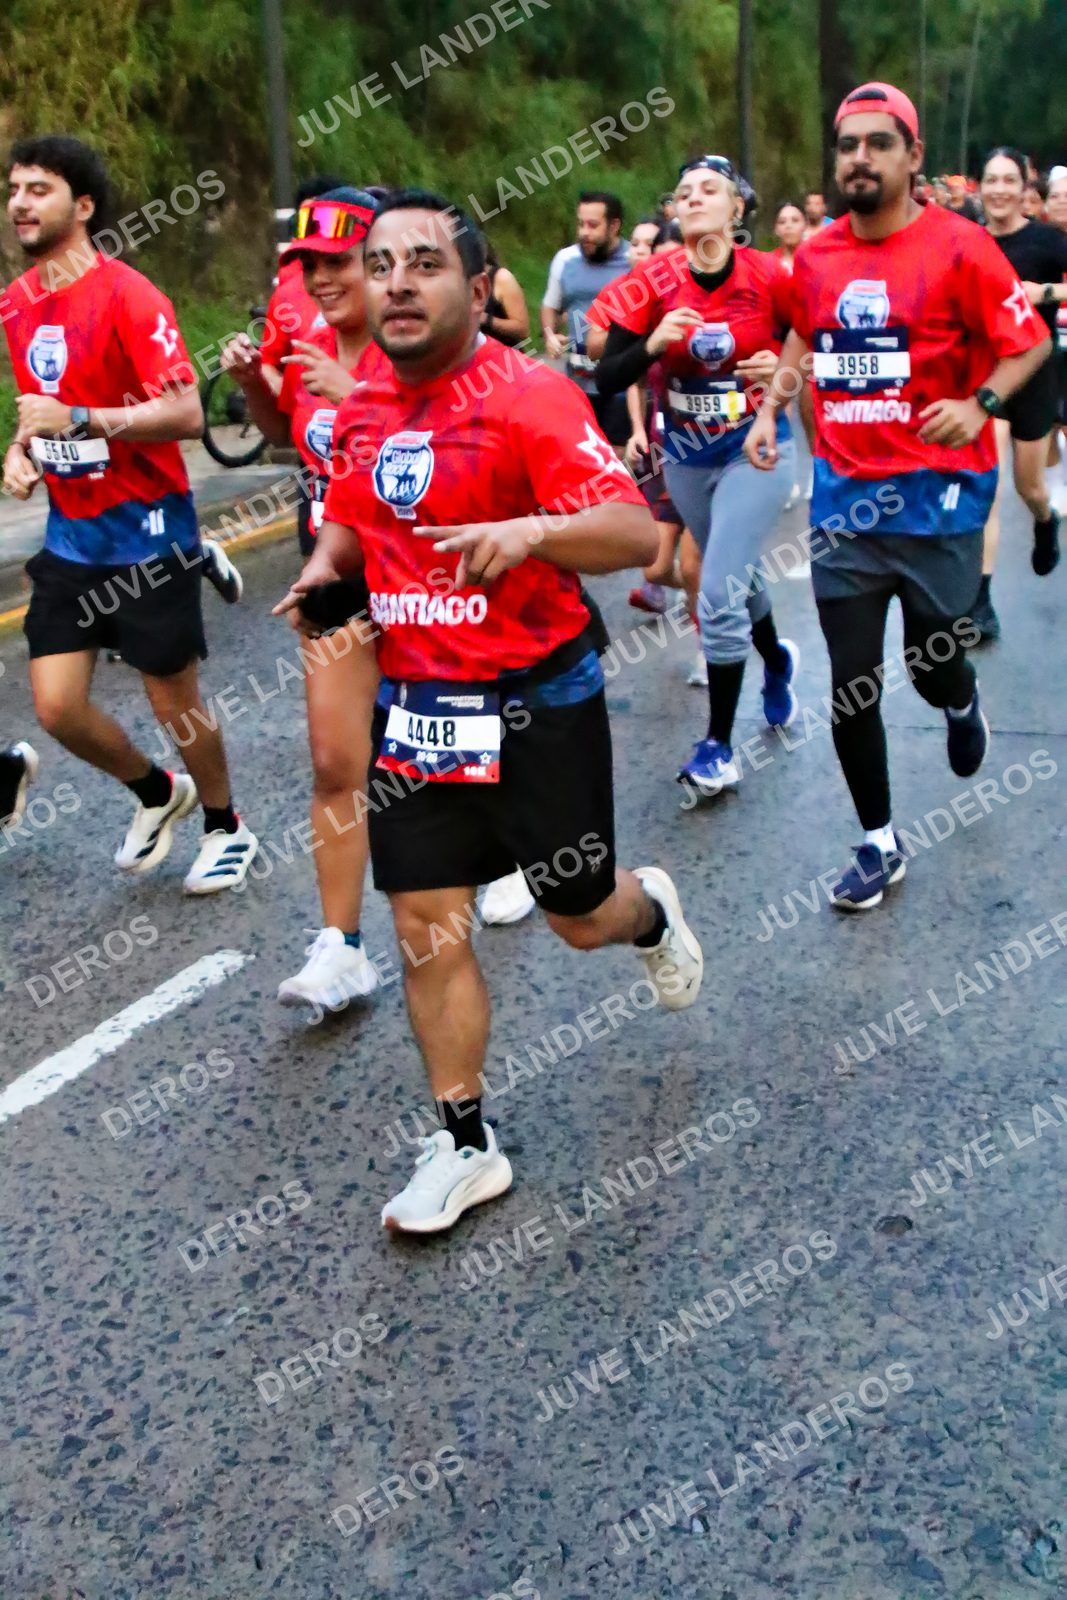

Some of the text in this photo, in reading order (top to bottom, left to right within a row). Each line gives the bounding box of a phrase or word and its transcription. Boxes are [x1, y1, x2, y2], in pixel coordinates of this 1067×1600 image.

[837, 355, 880, 376] 3958
[686, 395, 721, 412] 3959
[822, 399, 912, 423] SANTIAGO
[44, 440, 80, 461] 5540
[369, 592, 488, 626] SANTIAGO
[407, 716, 456, 748] 4448
